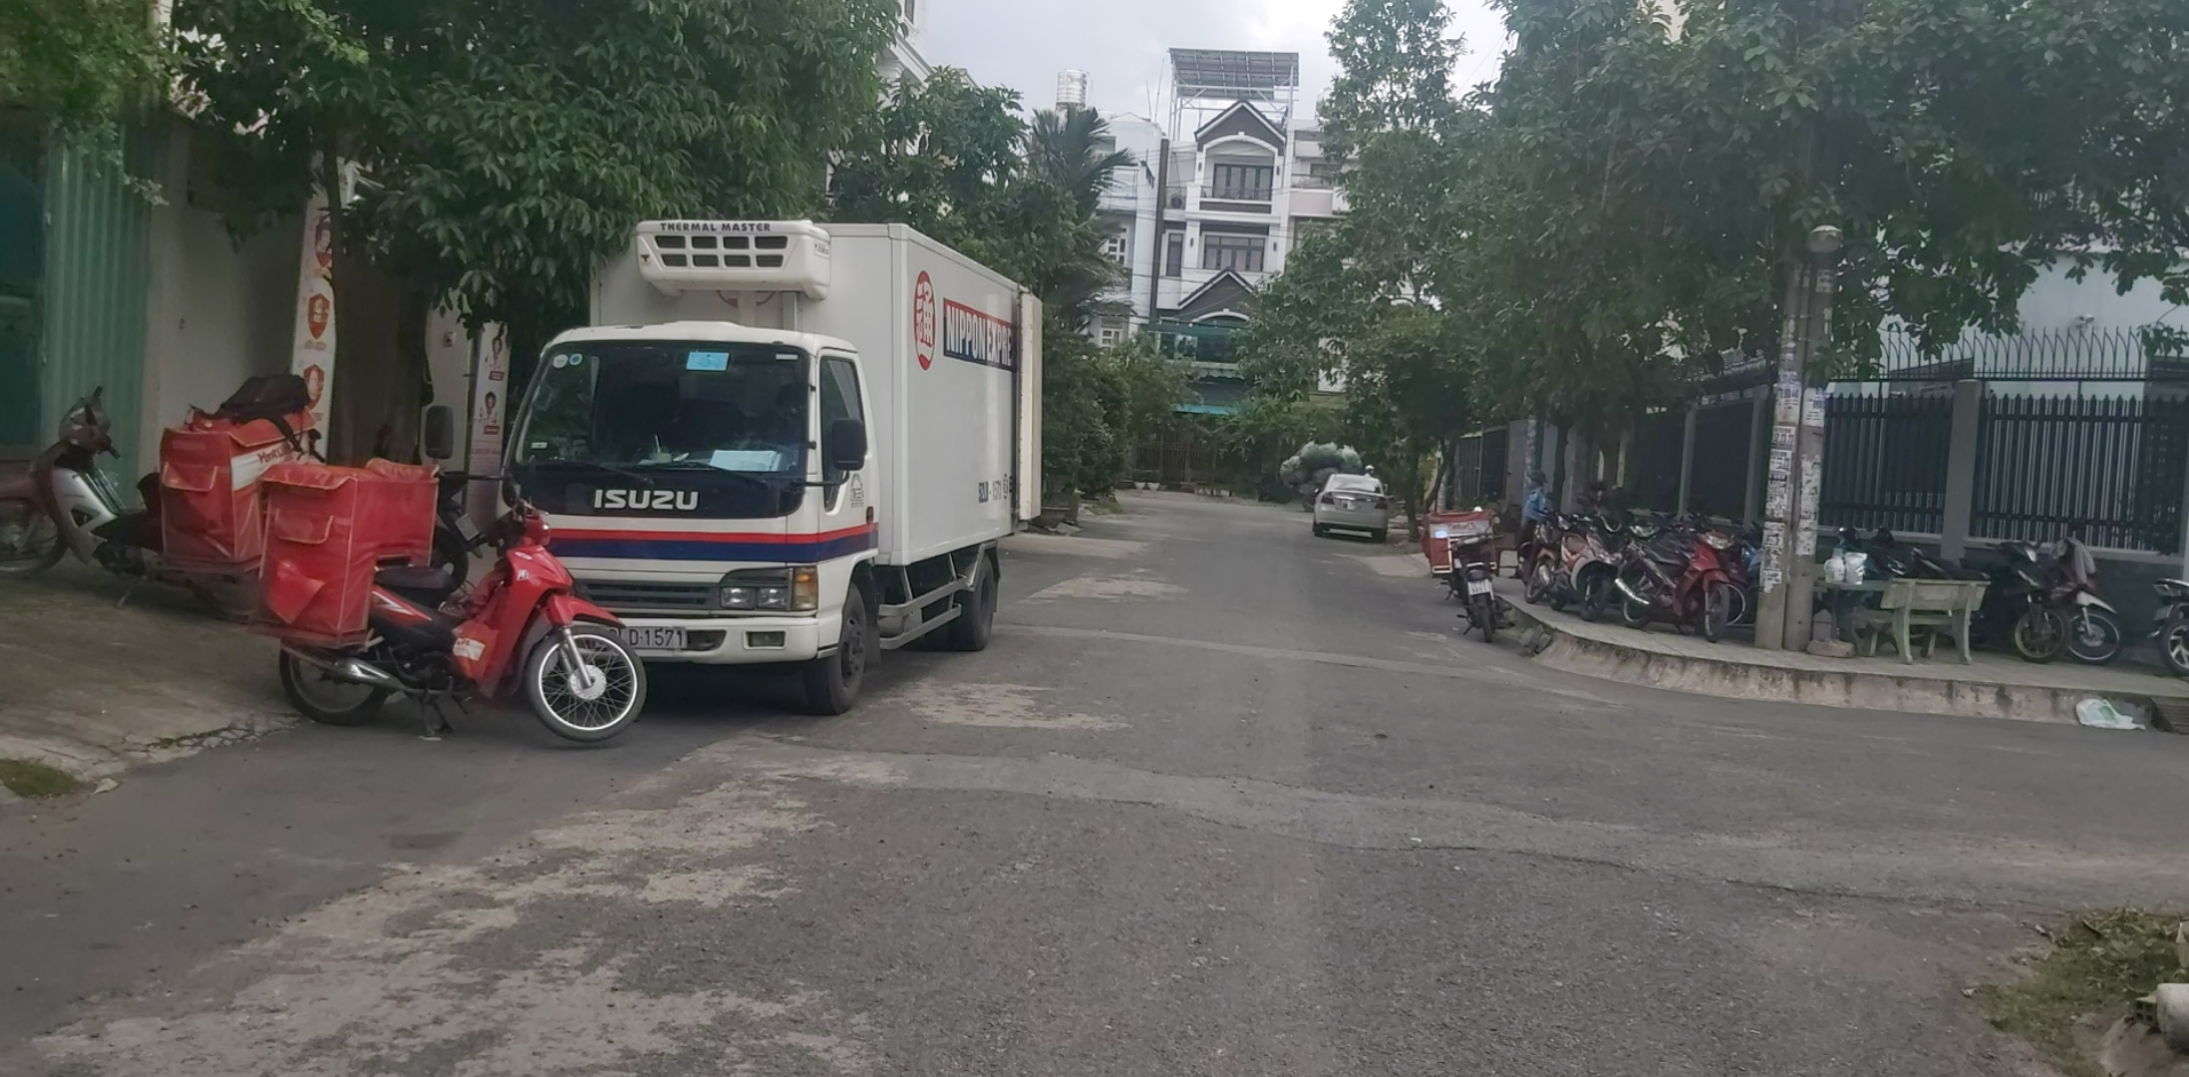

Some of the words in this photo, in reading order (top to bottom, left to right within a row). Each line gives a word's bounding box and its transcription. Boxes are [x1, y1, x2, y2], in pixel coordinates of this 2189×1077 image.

[660, 222, 717, 232] THERMAL
[721, 222, 771, 232] MASTER
[946, 304, 986, 361] NIPPON
[987, 319, 1012, 367] EXPRE
[594, 489, 699, 511] ISUZU
